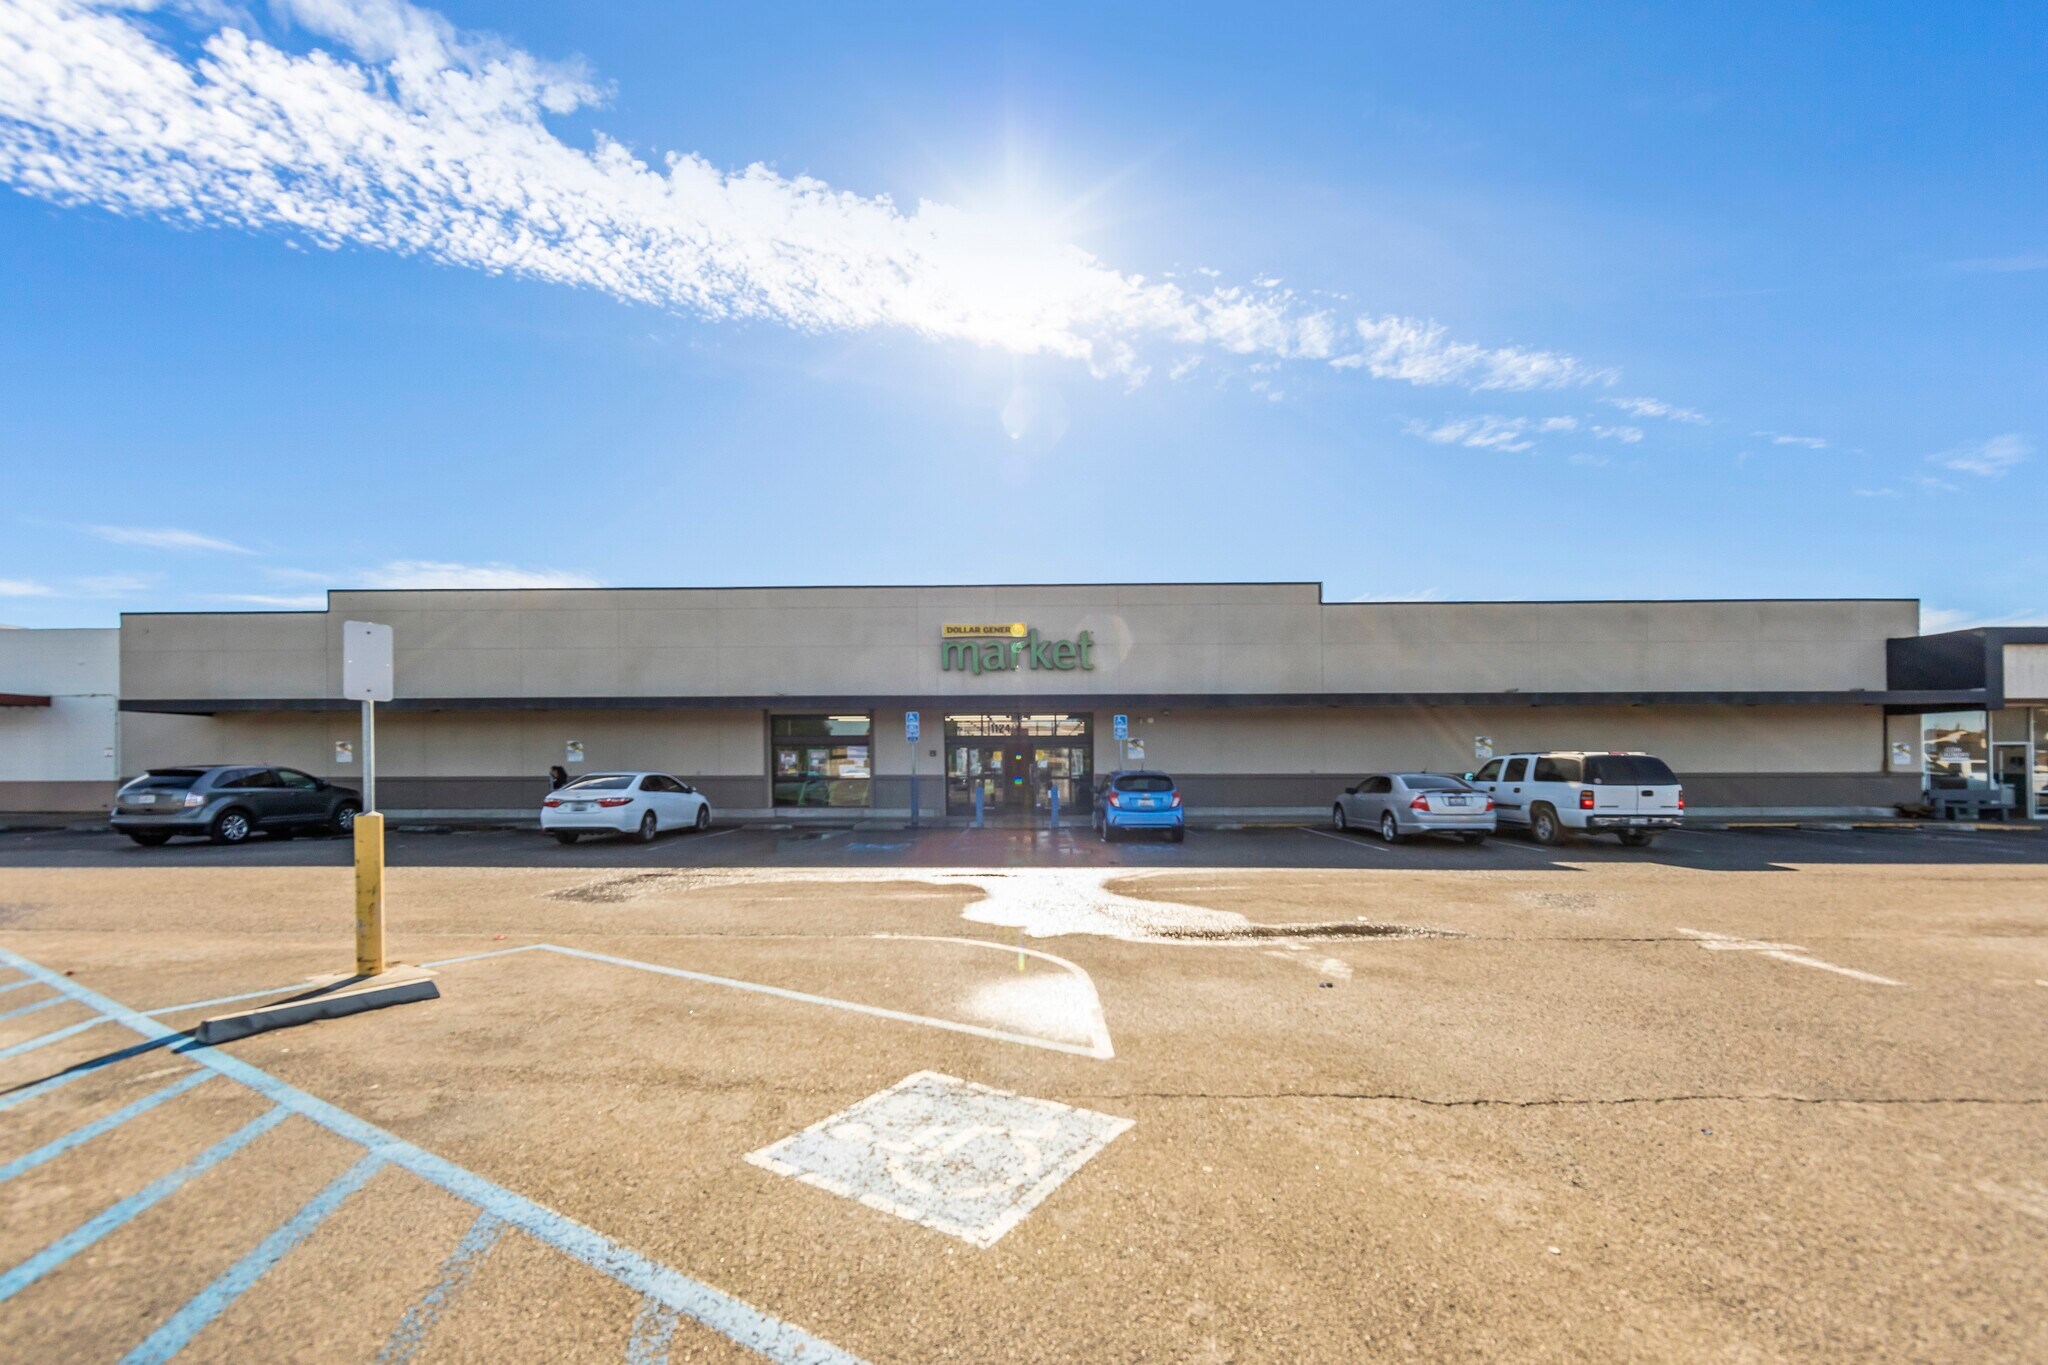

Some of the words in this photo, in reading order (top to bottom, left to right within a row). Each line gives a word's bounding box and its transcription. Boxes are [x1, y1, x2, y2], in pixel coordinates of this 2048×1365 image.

[946, 626, 981, 634] DOLLAR
[983, 626, 1023, 634] GENER
[941, 628, 1095, 675] market
